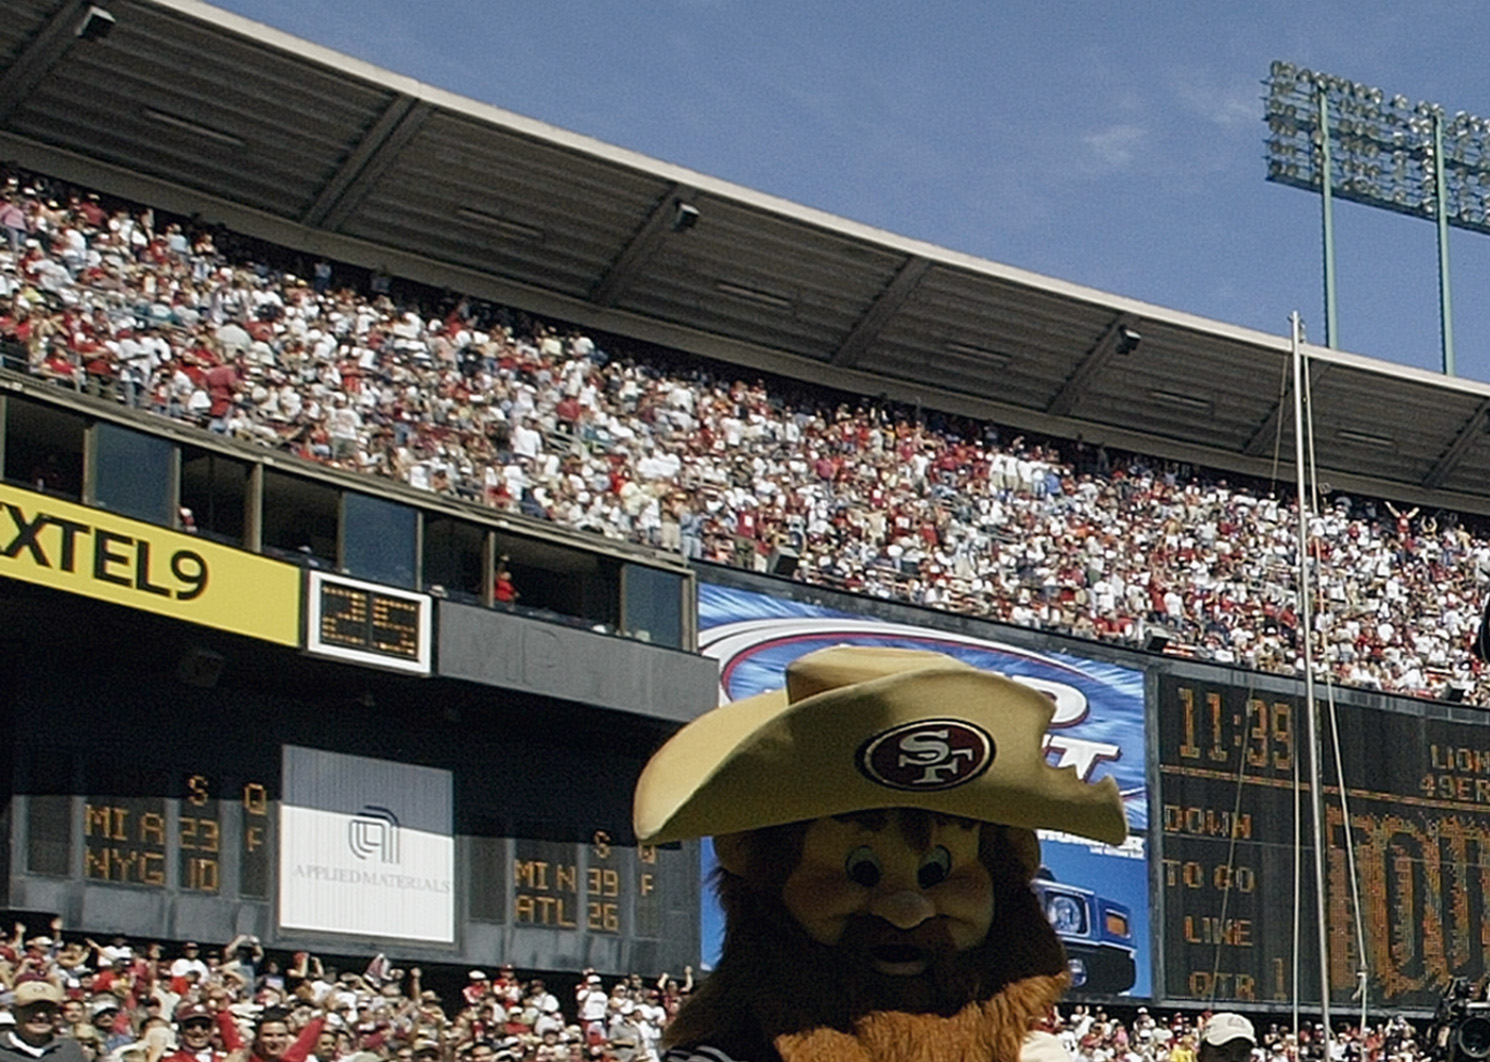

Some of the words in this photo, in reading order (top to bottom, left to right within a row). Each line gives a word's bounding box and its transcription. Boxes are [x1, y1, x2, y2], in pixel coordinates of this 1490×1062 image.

[0, 502, 210, 601] XTEL9
[1178, 687, 1293, 770] 11:39
[900, 729, 973, 784] SF
[188, 775, 209, 806] S
[244, 783, 268, 815] Q
[179, 816, 219, 852] 23
[247, 827, 263, 852] F
[1164, 804, 1251, 839] DOWN
[594, 830, 610, 859] S
[85, 844, 165, 885] NYG
[189, 857, 219, 892] 10
[294, 864, 361, 884] APPLIED
[362, 870, 451, 894] MATERIALS
[587, 867, 619, 897] 39
[641, 873, 654, 897] F
[1162, 859, 1204, 888] TO
[1214, 864, 1255, 893] GO
[515, 894, 577, 928] ATL
[587, 902, 619, 932] 26
[1189, 971, 1255, 1002] QTR
